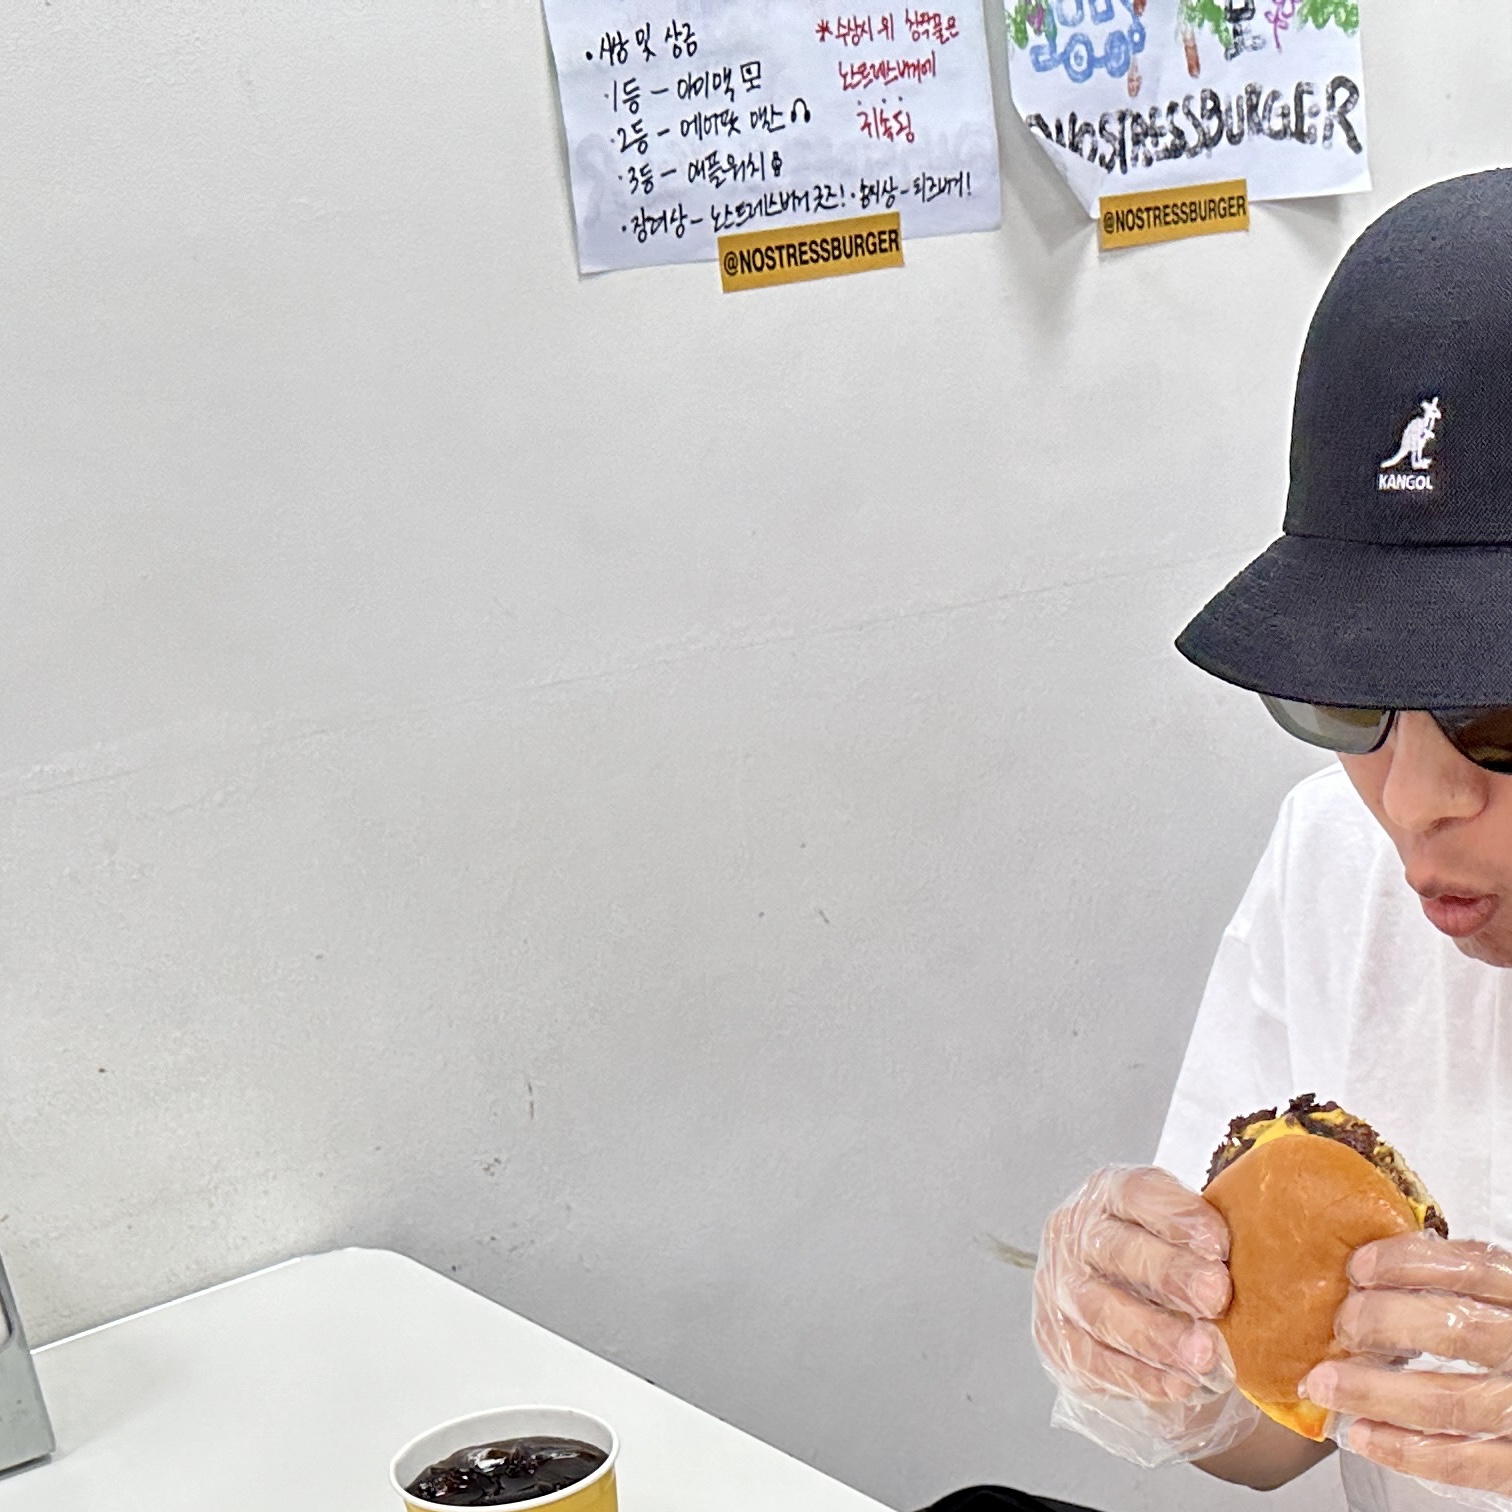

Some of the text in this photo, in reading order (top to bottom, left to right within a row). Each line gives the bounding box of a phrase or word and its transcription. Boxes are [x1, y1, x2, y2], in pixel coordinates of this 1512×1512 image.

[635, 22, 656, 62] 및
[665, 19, 698, 59] 상금
[878, 13, 895, 41] 위
[614, 77, 640, 114] 1등
[677, 66, 735, 102] 아이맥
[617, 118, 648, 155] 2등
[680, 109, 741, 140] 에어팟
[628, 163, 654, 195] 3등
[688, 150, 765, 189] 애플워치
[1103, 194, 1247, 235] @NOSTRESSBURGER
[723, 228, 900, 276] @NOSTRESSBURGER
[1378, 473, 1434, 490] KANGOL
